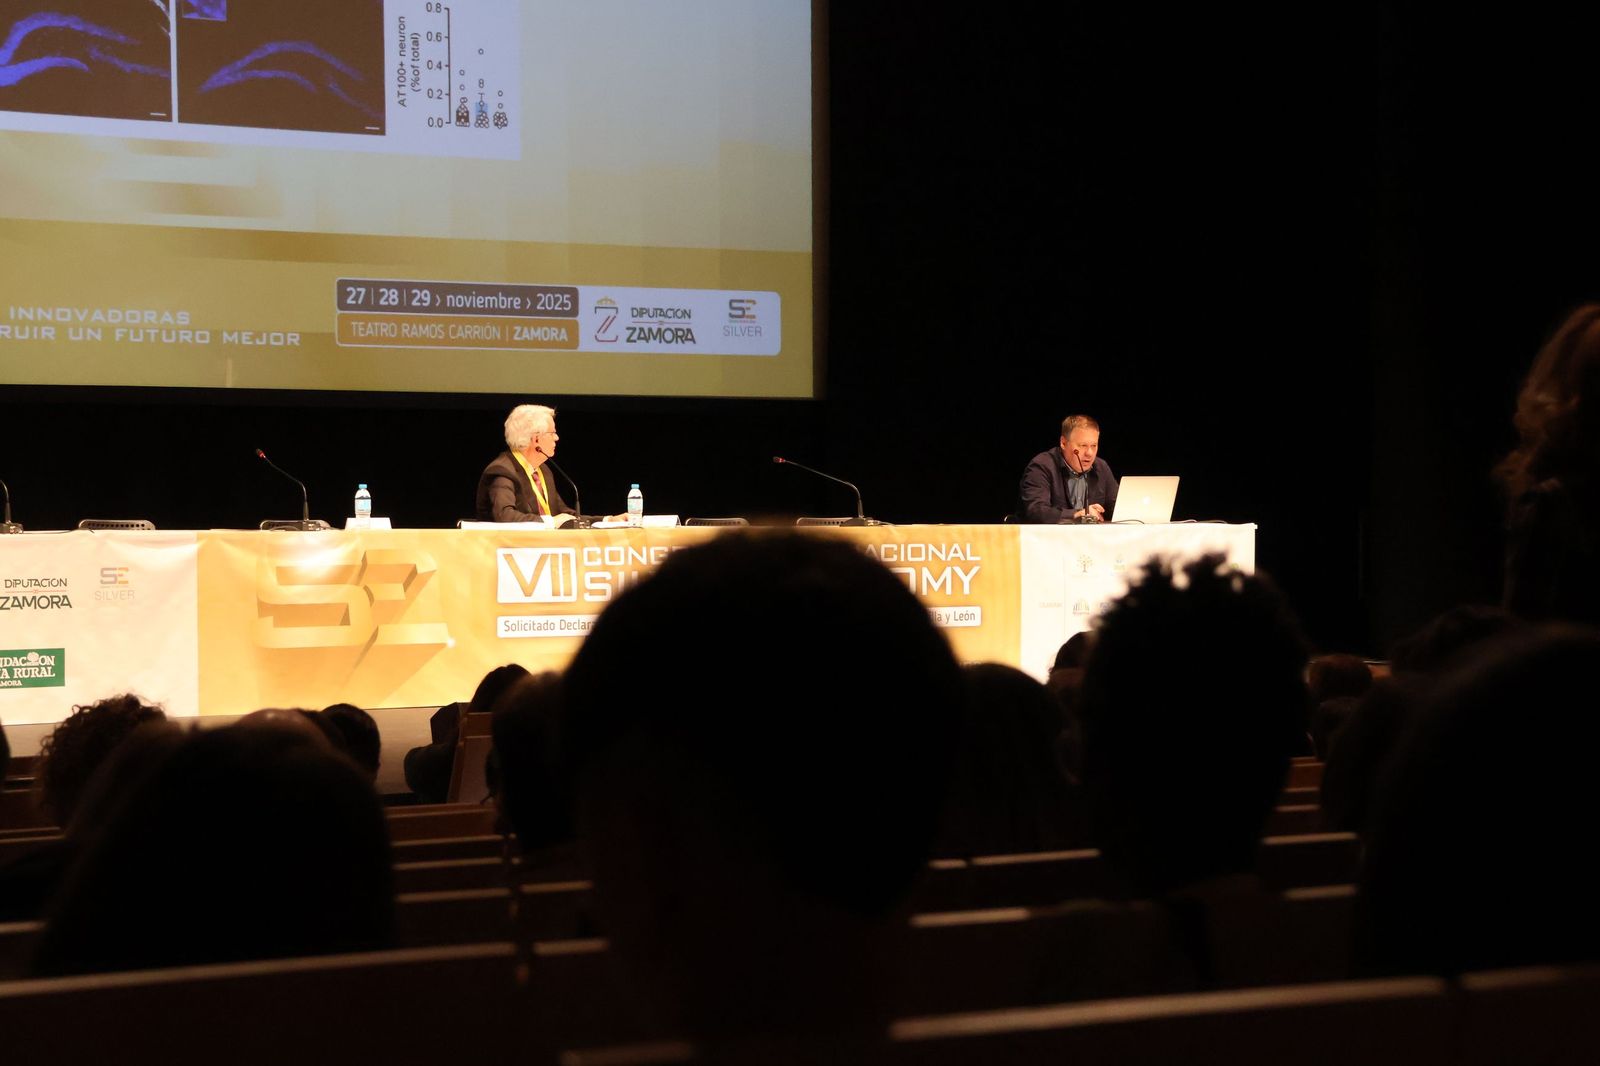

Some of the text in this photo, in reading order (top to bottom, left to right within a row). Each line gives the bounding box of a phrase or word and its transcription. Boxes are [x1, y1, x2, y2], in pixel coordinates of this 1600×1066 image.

[426, 2, 442, 13] 0.8
[398, 16, 406, 56] neuron
[426, 31, 442, 42] 0.6
[427, 60, 442, 71] 0.4
[427, 88, 443, 100] 0.2
[428, 117, 444, 128] 0.0
[346, 286, 572, 311] 27 28 29 noviembre 2025
[9, 305, 191, 325] INNOVADORAS
[68, 327, 102, 341] UN
[115, 328, 210, 344] FUTURO
[222, 331, 300, 346] MEJOR
[351, 321, 568, 342] TEATRO RAMOS CARRIÓN ZAMORA
[626, 326, 697, 345] ZAMORA
[722, 325, 763, 338] SILVER
[583, 543, 982, 567] CONG ACIONAL
[0, 594, 72, 611] ZAMORA
[94, 589, 136, 601] SILVER
[503, 619, 556, 633] Solicitado
[945, 613, 951, 625] y
[953, 609, 976, 622] León
[14, 666, 55, 679] RURAL
